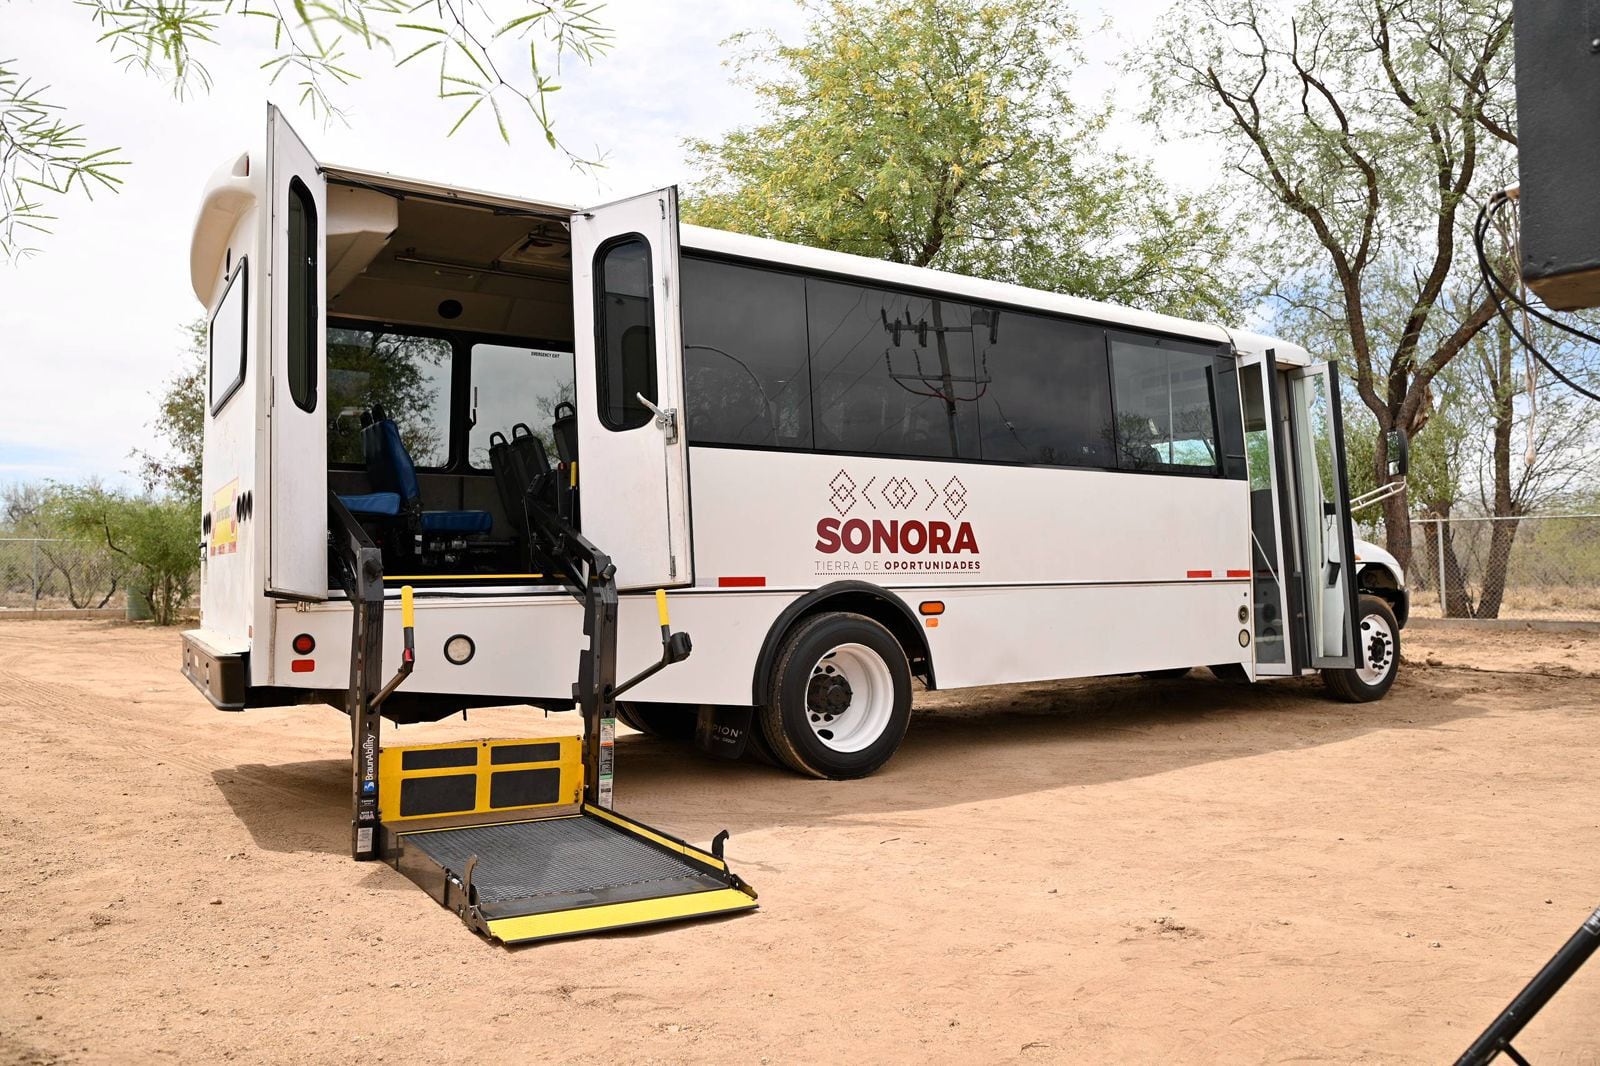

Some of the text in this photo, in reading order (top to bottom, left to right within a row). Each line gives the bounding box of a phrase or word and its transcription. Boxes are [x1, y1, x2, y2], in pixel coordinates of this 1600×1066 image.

[815, 517, 979, 554] SONORA
[815, 560, 981, 571] TIERRA DE OPORTUNIDADES
[363, 733, 376, 780] BraunAbility
